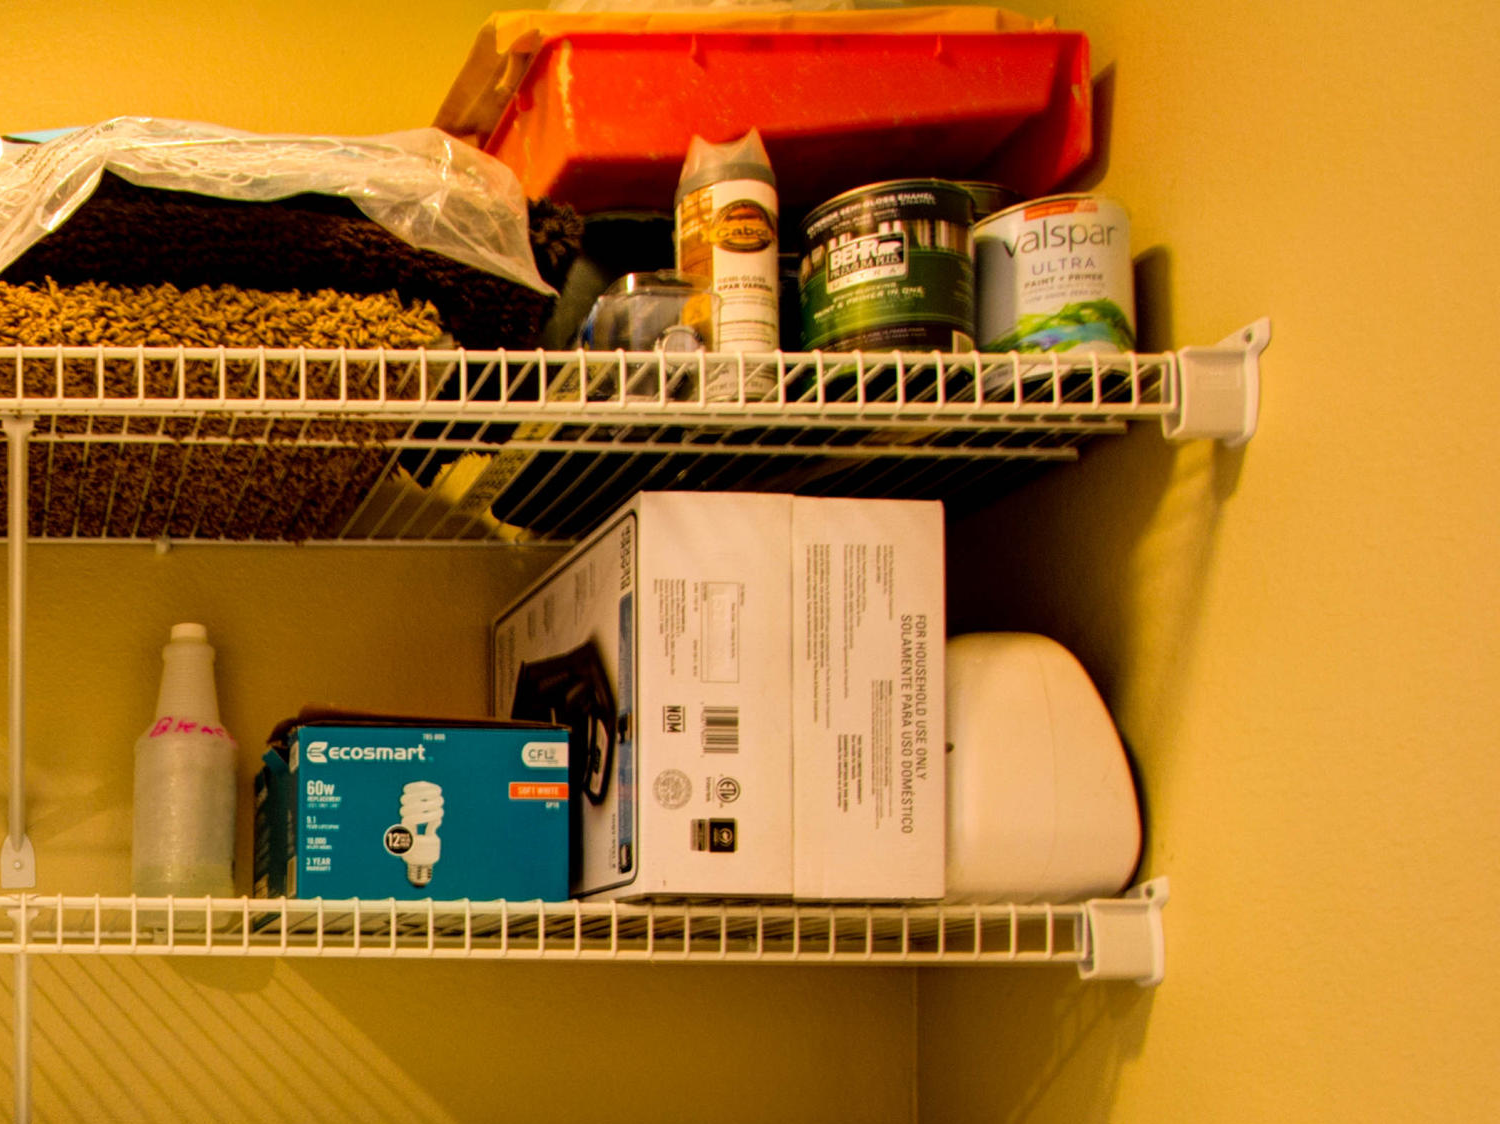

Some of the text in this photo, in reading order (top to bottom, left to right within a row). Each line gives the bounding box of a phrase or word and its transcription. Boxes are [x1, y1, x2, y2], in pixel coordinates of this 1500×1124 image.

[1002, 220, 1116, 258] valspar
[829, 238, 879, 270] BEHR
[876, 252, 901, 267] PLUS
[1032, 257, 1095, 276] ULTRA
[831, 268, 899, 290] ULTRA
[1024, 277, 1055, 288] PAINT
[915, 614, 927, 780] FOR HOUSEHOLD USE ONLY
[667, 705, 682, 733] NOM
[901, 614, 915, 834] SOLAMENTE PARA USO DOMÉSTICO
[388, 833, 400, 847] 12
[313, 857, 331, 866] YEAR
